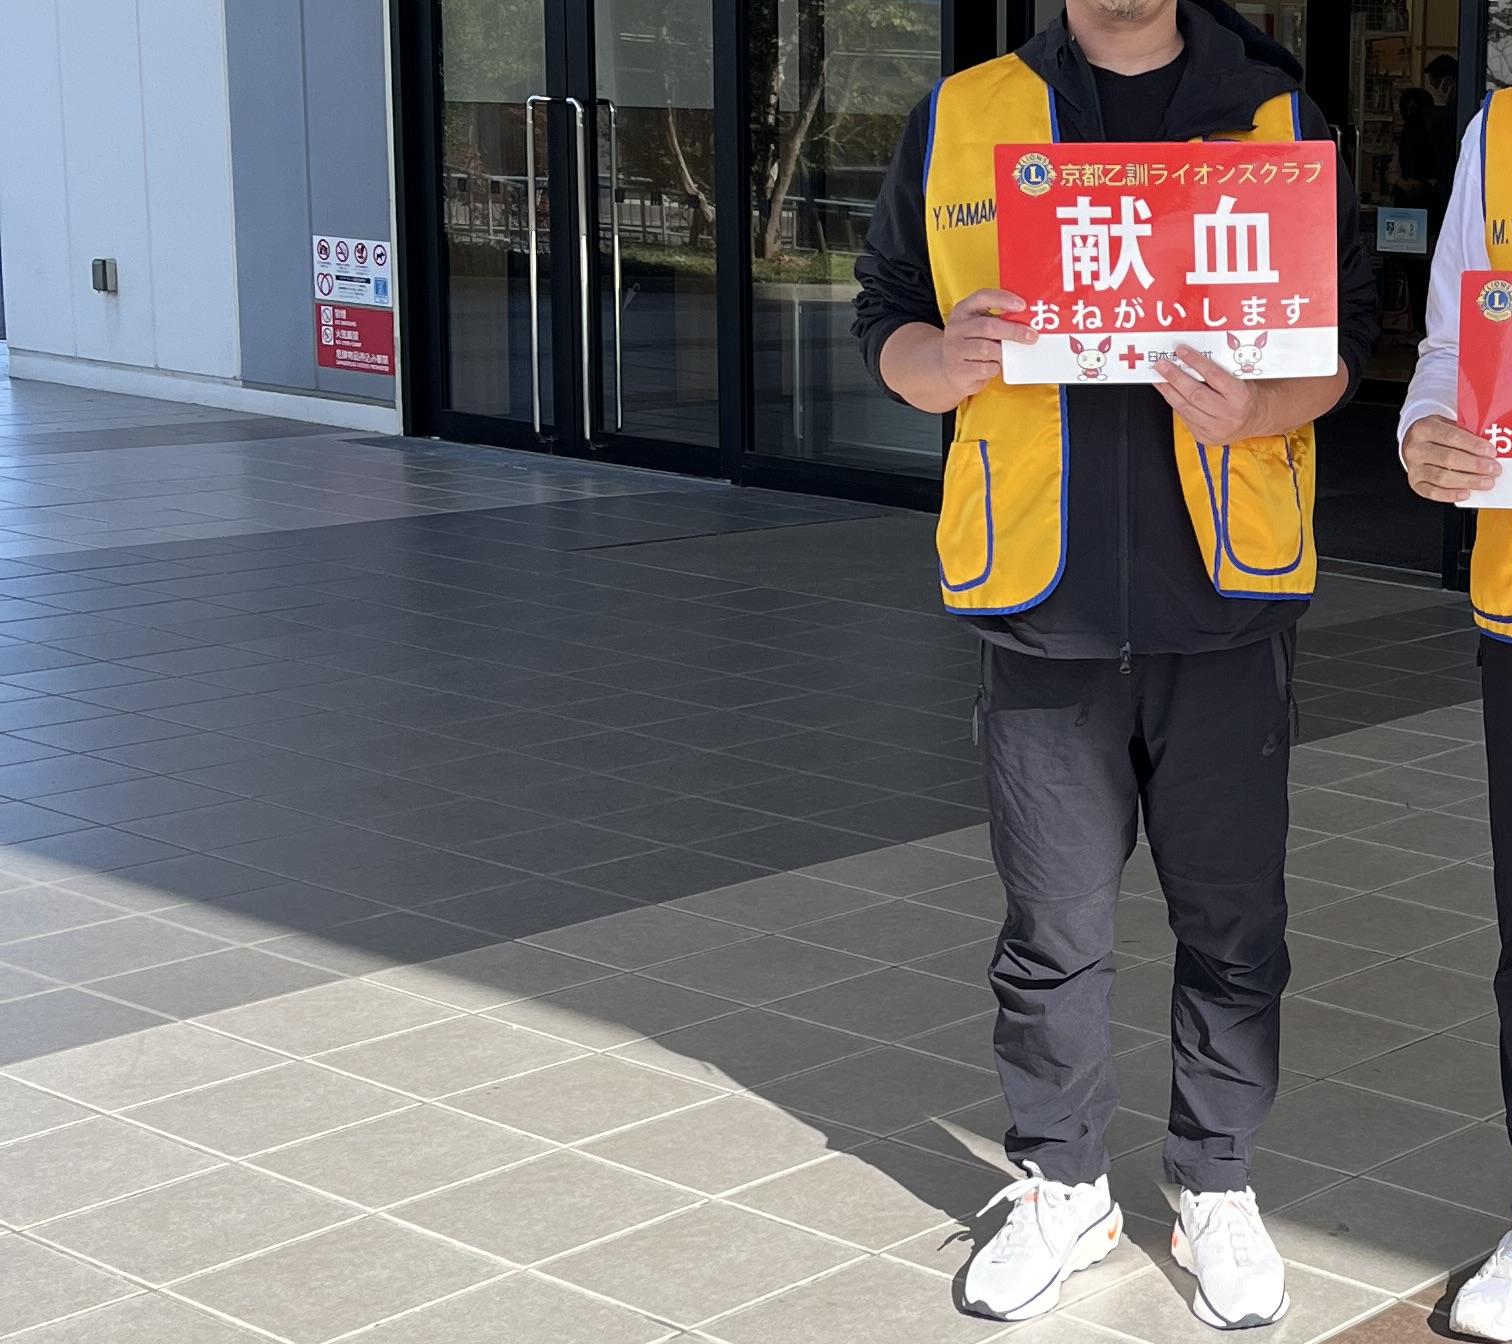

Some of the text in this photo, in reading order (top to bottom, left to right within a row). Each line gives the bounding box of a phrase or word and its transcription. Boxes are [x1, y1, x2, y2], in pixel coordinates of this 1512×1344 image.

[1029, 165, 1042, 183] L
[1059, 160, 1324, 187] 京都乙訓ライオンズクラブ
[1055, 194, 1280, 292] 献血
[1029, 294, 1310, 330] おねがいします
[1493, 292, 1505, 308] L
